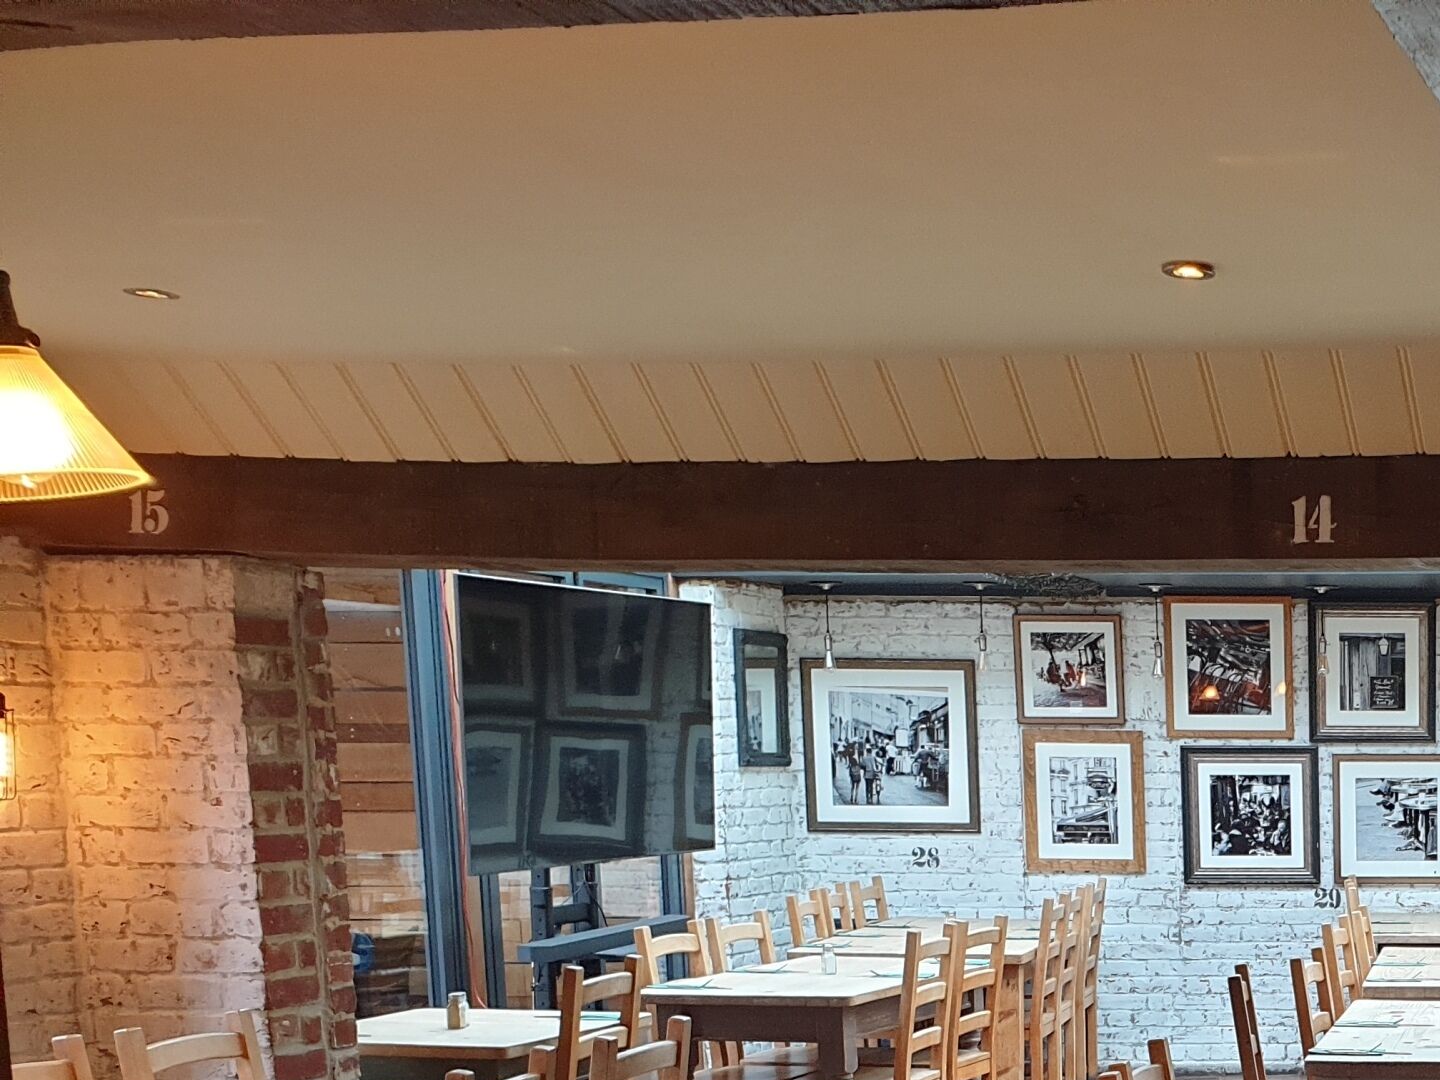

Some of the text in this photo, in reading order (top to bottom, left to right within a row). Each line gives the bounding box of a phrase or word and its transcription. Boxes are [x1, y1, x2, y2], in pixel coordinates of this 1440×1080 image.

[128, 489, 169, 535] 15
[1291, 494, 1338, 544] 14
[912, 846, 940, 869] 28
[1314, 887, 1341, 909] 29
